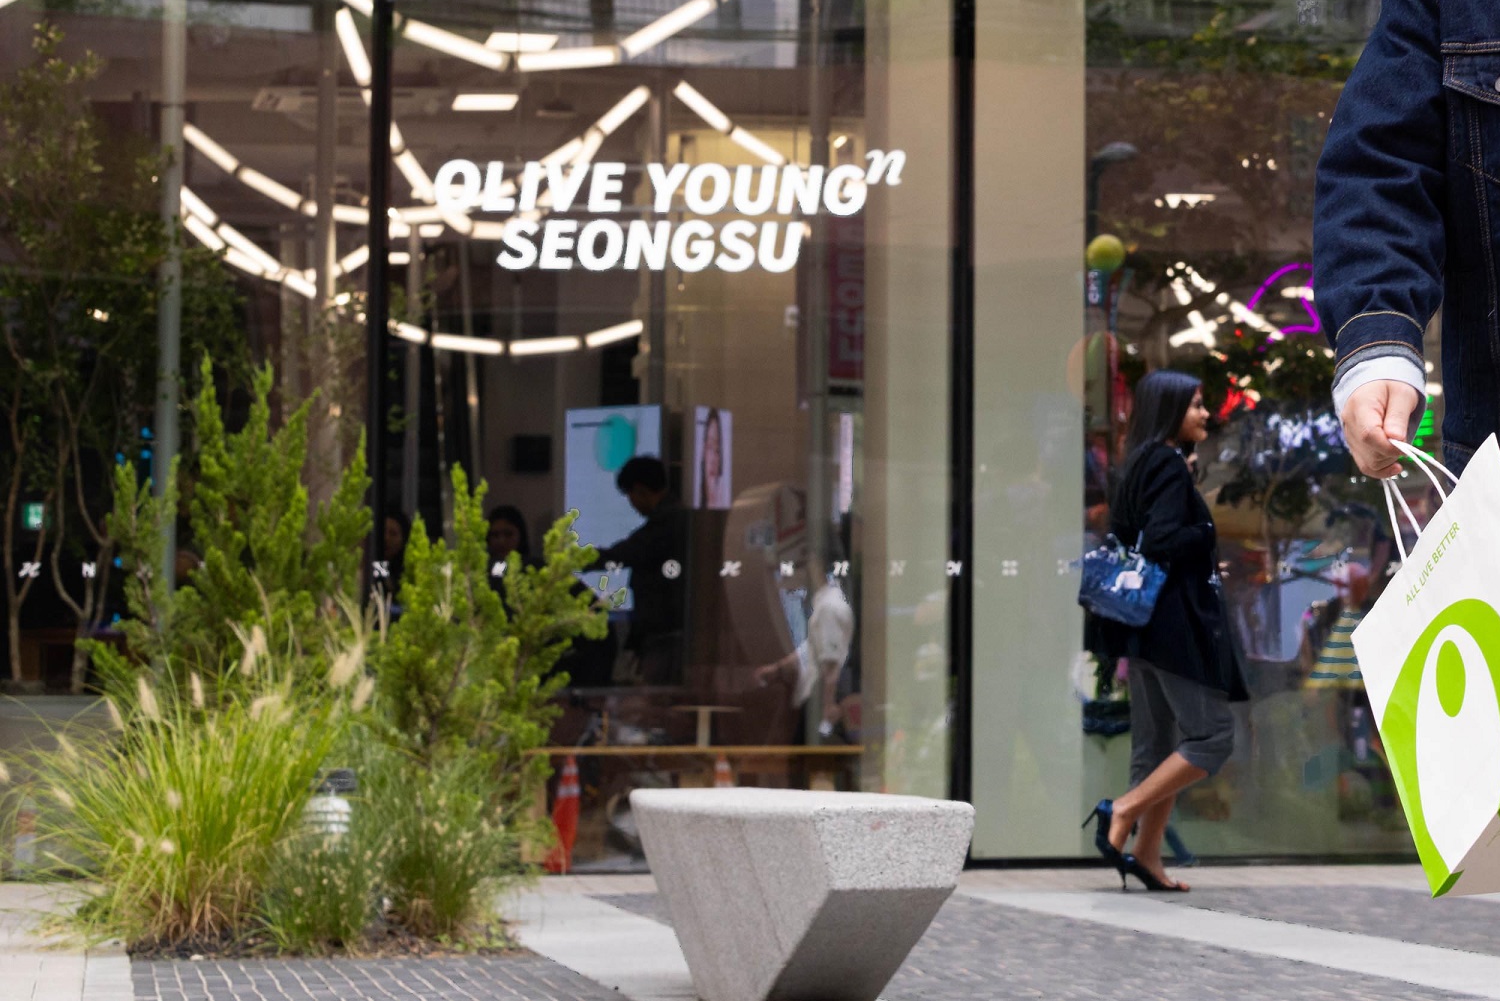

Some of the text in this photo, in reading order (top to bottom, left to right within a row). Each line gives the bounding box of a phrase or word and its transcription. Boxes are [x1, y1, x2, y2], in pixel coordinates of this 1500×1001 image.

[433, 158, 626, 213] OLIVE
[496, 218, 802, 273] SEONGSU
[1405, 521, 1460, 606] ALL LIVE BETTER
